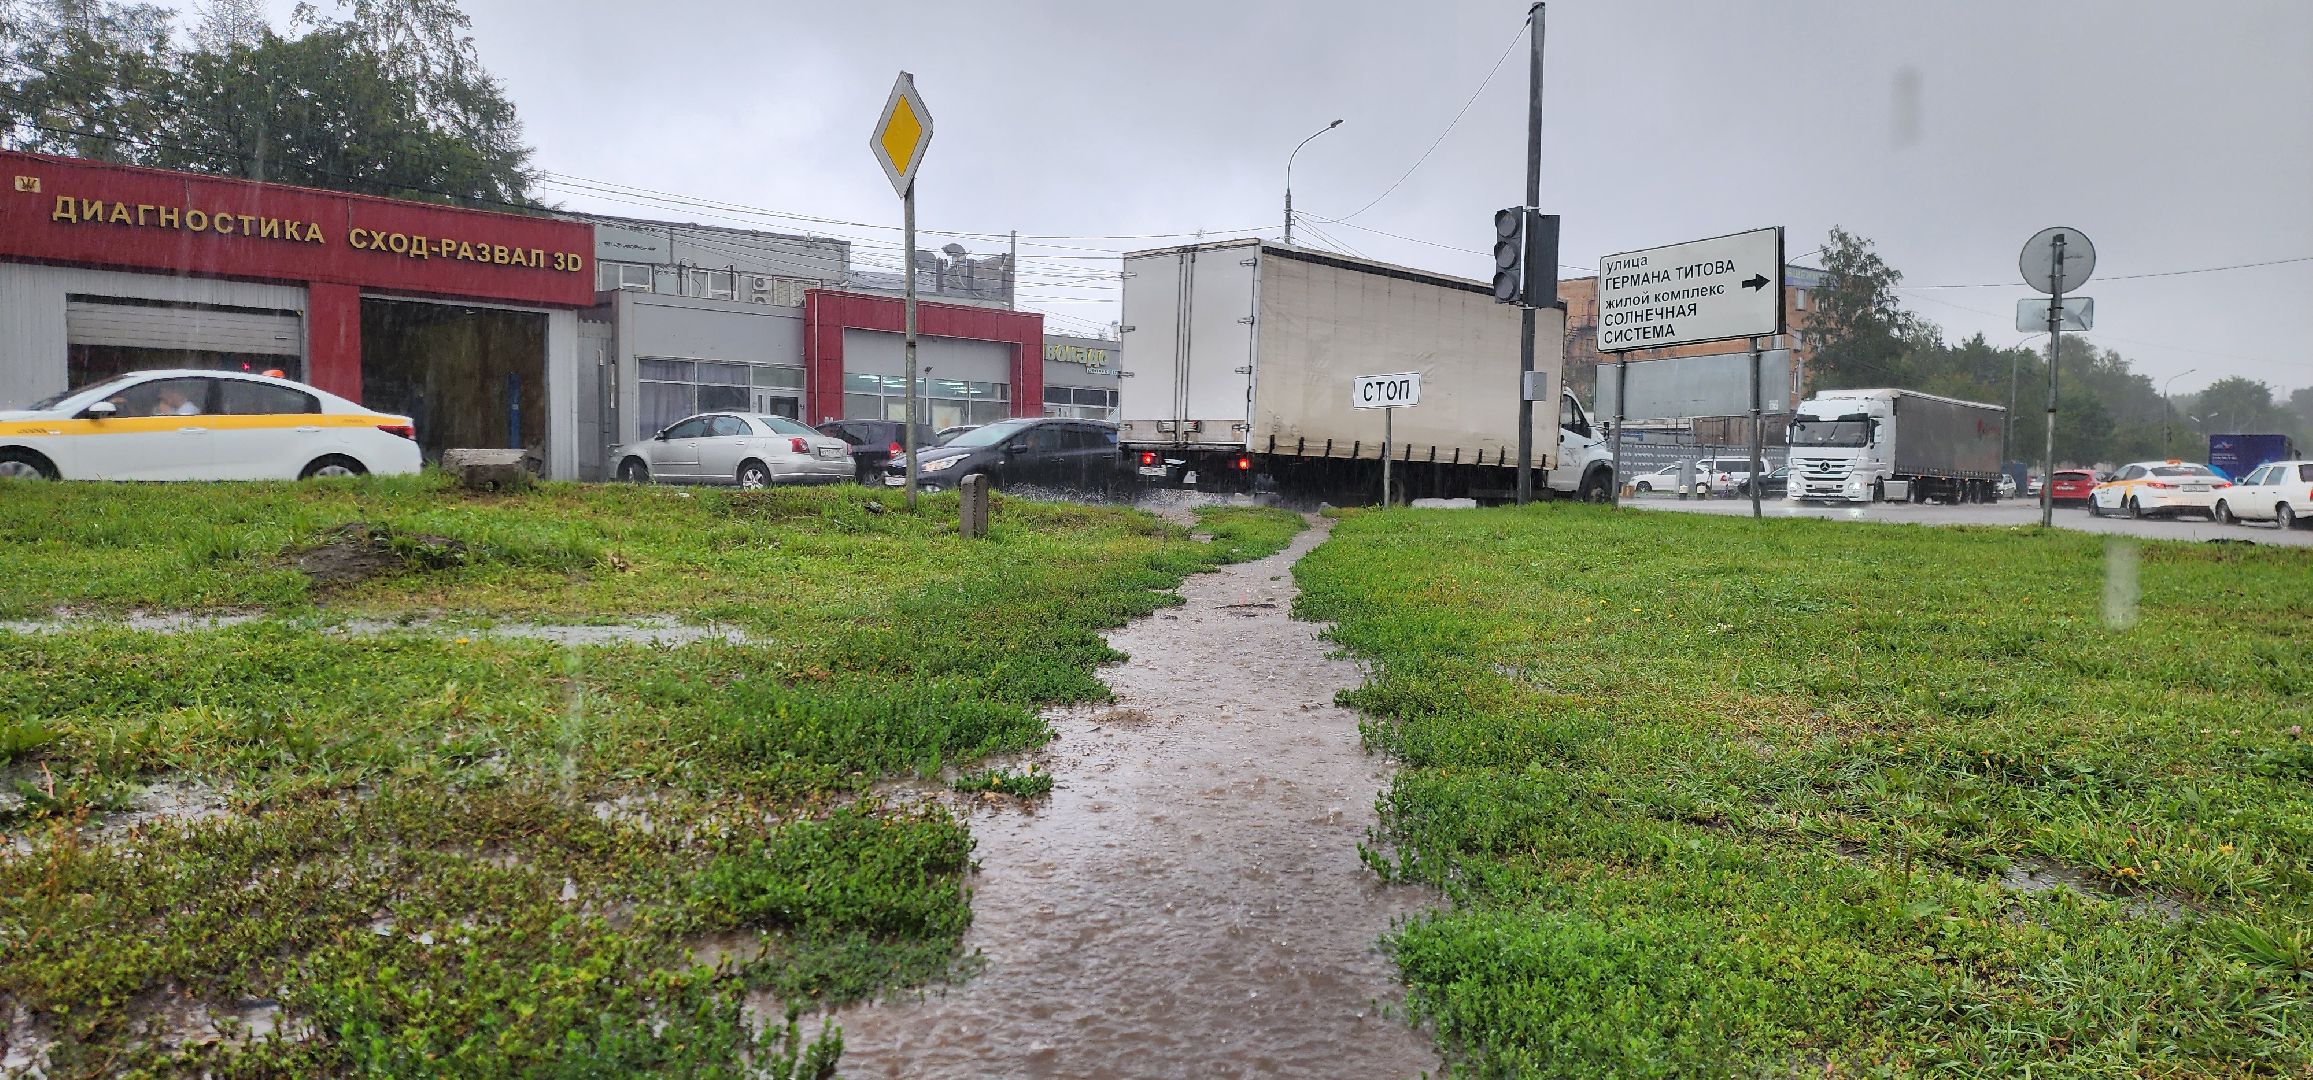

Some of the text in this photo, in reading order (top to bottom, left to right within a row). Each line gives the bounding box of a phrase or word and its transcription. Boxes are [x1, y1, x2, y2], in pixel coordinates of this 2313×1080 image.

[52, 195, 583, 272] ДИАГНОСТИКА СХОД-РАЗВАЛ 3D
[1605, 259, 1736, 291] ГЕРМАНА ТИТОВА
[1606, 256, 1648, 275] улица
[1605, 284, 1725, 310] жилой комплекс
[1604, 303, 1697, 327] СОЛНЕЧНАЯ
[1604, 324, 1676, 344] СИСТЕМА
[1363, 380, 1410, 402] СТОП
